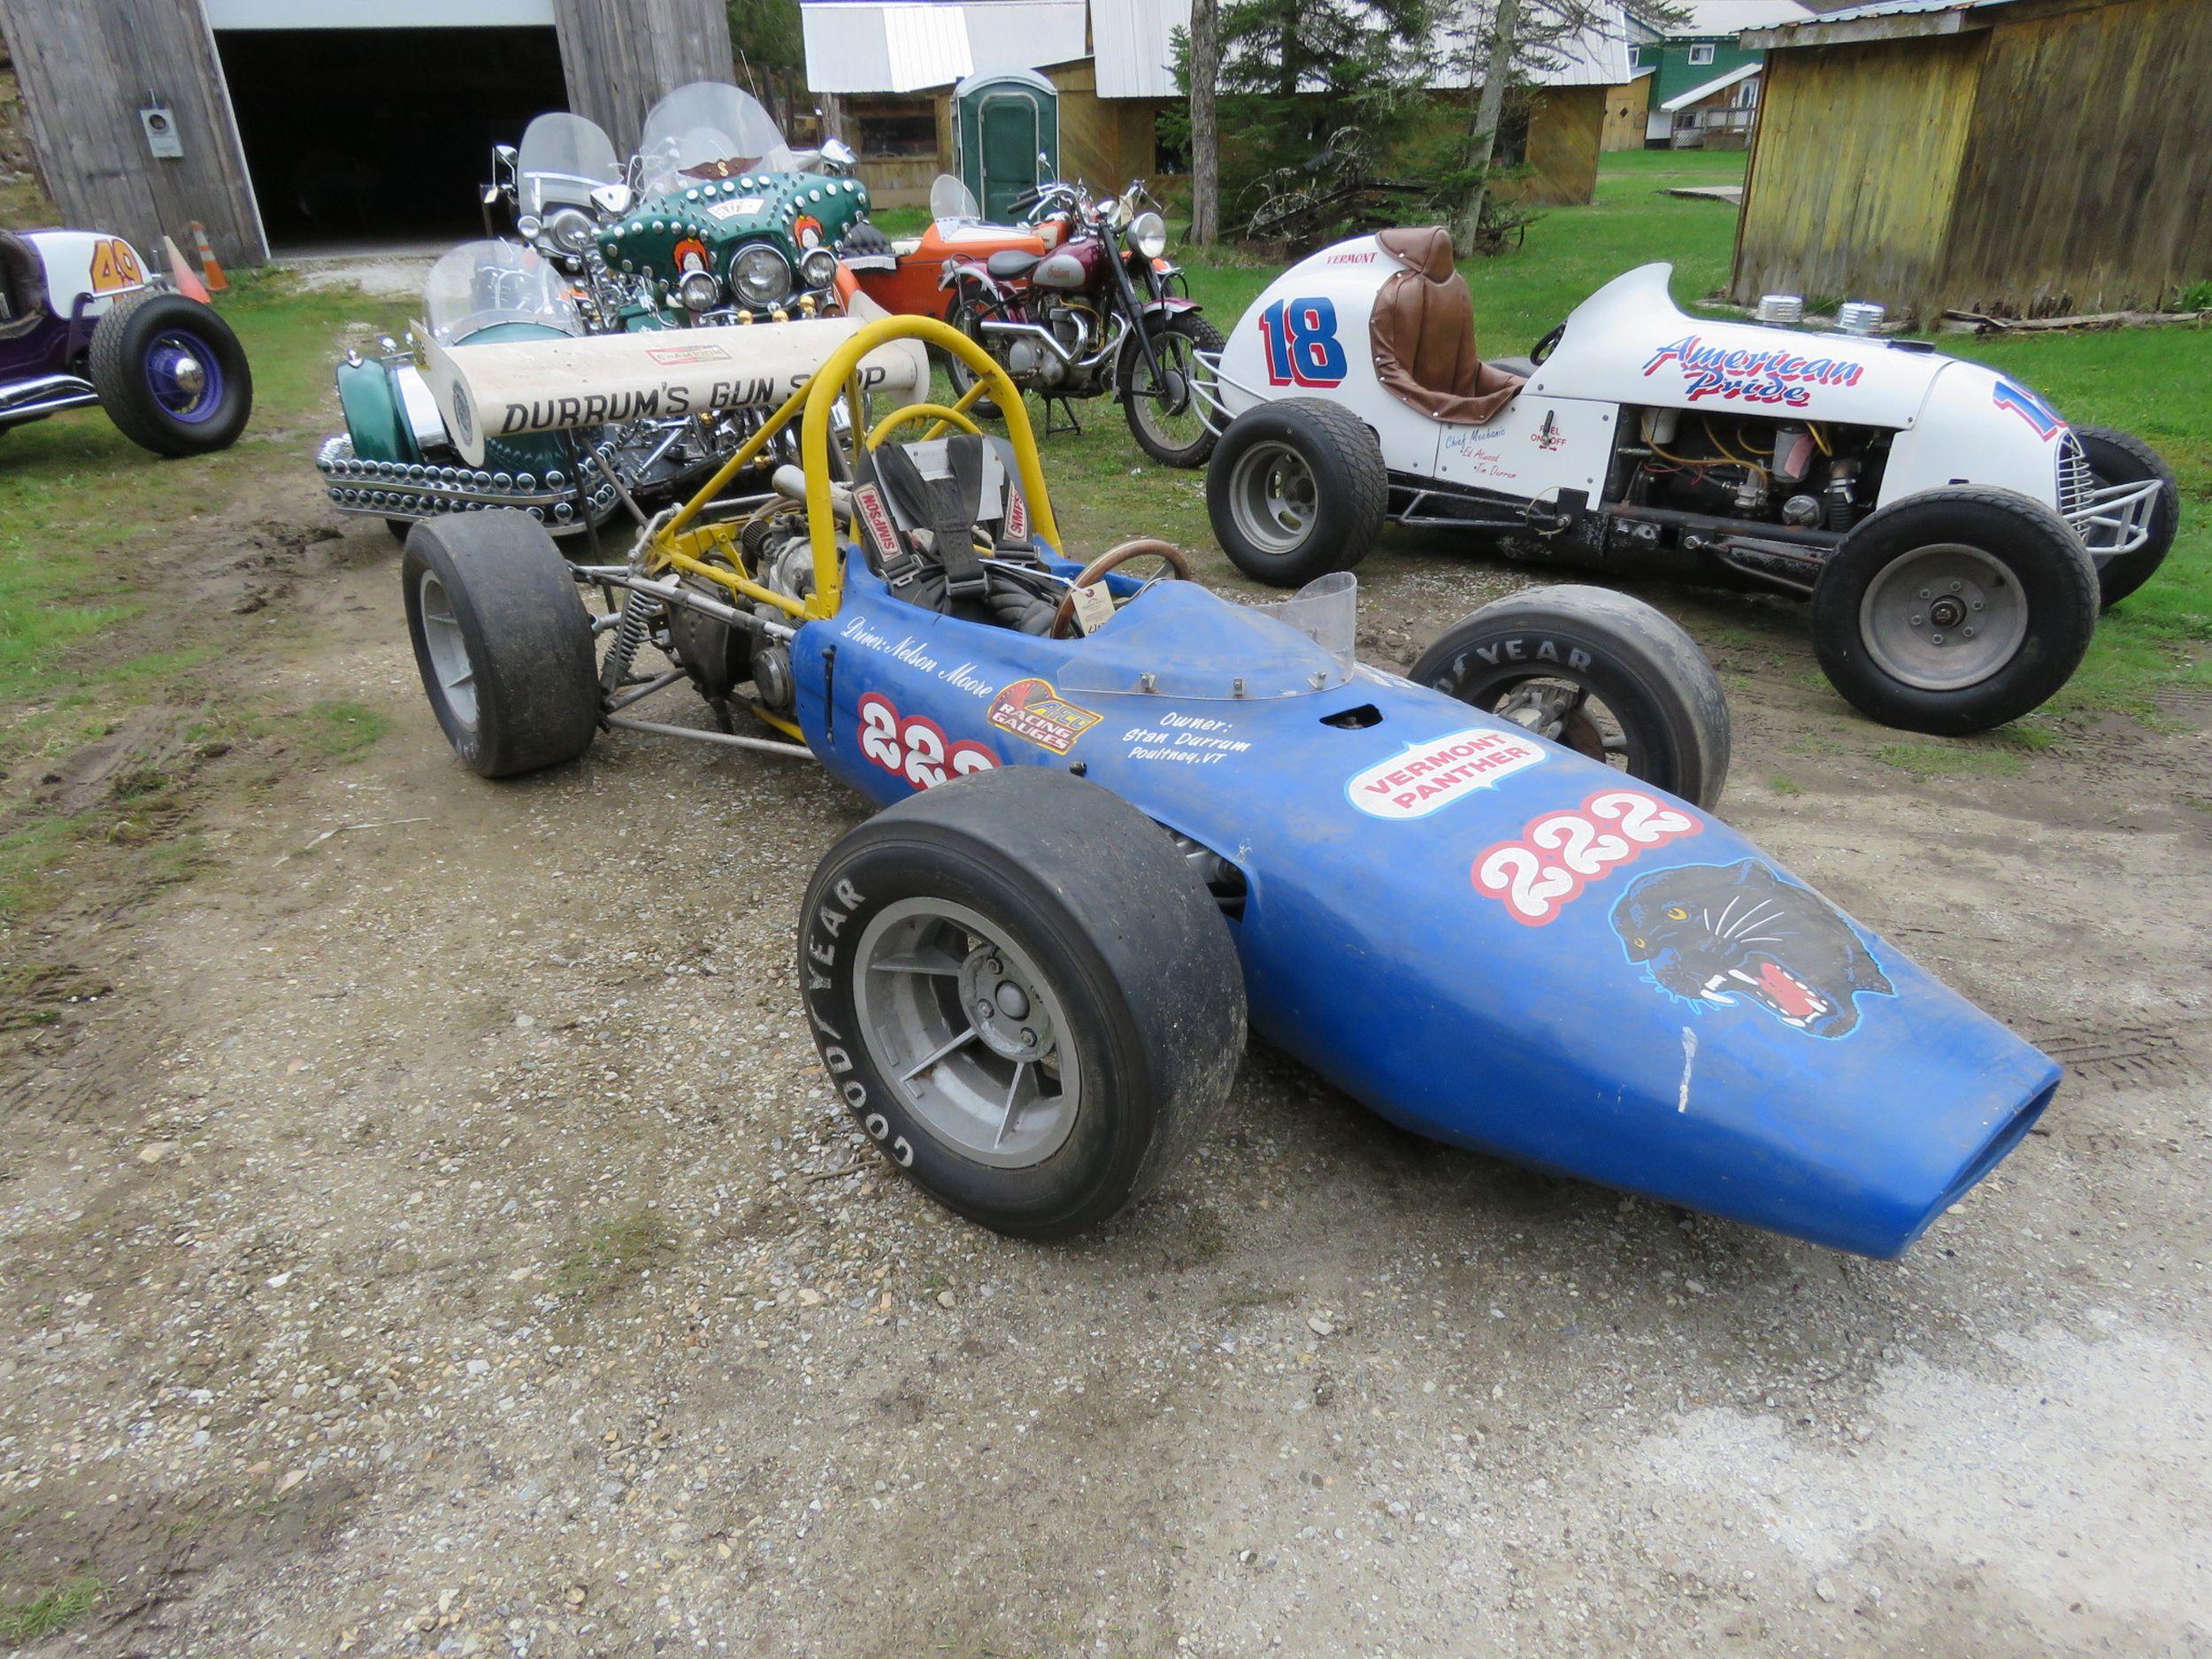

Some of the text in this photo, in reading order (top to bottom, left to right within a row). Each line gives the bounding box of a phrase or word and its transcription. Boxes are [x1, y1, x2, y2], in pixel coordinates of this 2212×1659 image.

[1327, 252, 1378, 265] VERMONT
[1258, 296, 1348, 388] 18
[1642, 334, 1864, 387] American
[501, 381, 689, 434] DURRUM'S
[710, 377, 774, 409] GUN
[787, 366, 887, 400] SP
[1682, 366, 1811, 408] Pride
[1445, 432, 1466, 449] Chief
[1530, 433, 1567, 445] ON OFF
[1540, 425, 1561, 435] FEL
[862, 494, 895, 550] SIMPSON
[841, 616, 993, 698] Driver: Nelson Moore
[992, 711, 1070, 750] GAUGES
[999, 703, 1073, 740] RACING
[1122, 728, 1252, 752] Stan Durrum
[1160, 711, 1233, 733] Owner:
[1363, 733, 1508, 795] VERMONT
[1392, 746, 1532, 809] PANTHER
[1475, 790, 1699, 923] 222
